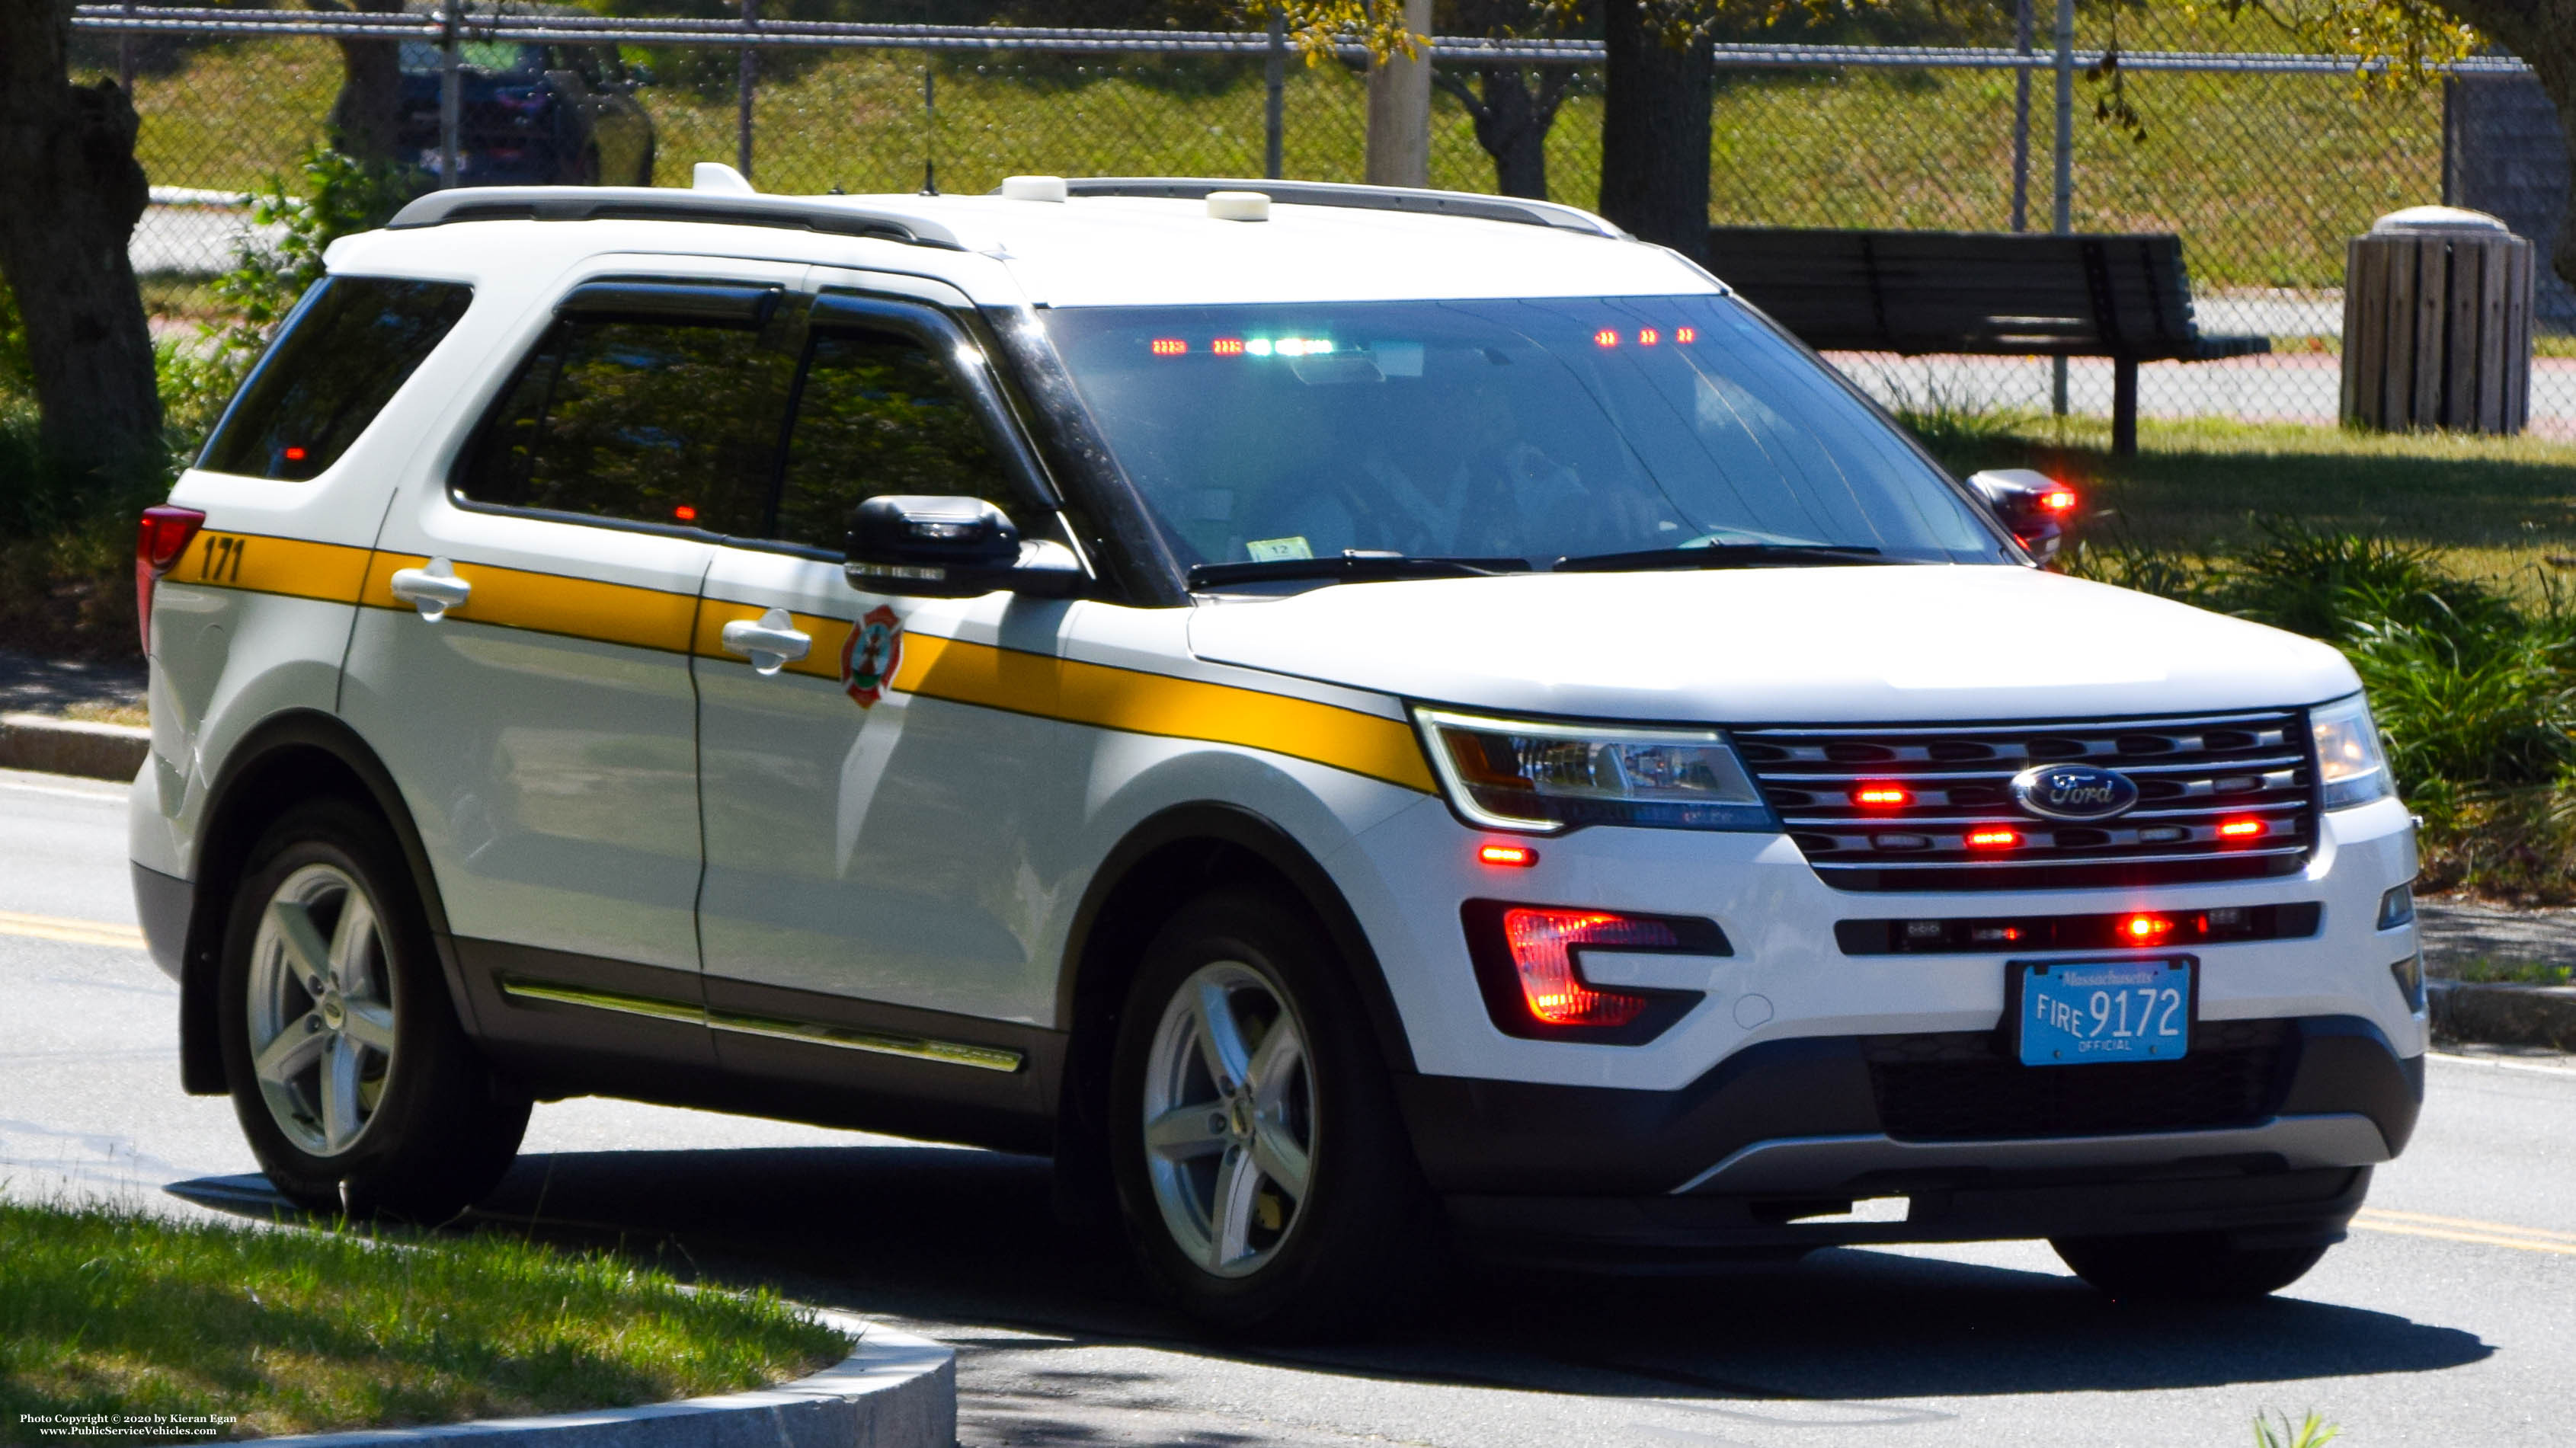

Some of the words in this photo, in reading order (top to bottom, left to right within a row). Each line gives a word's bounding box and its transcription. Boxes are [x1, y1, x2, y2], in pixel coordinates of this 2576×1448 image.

[202, 535, 245, 582] 171
[2050, 773, 2115, 804] Ford
[2062, 970, 2153, 987] Massachusetts
[2037, 993, 2084, 1038] FIRE
[2089, 989, 2181, 1037] 9172
[2078, 1040, 2133, 1053] OFFICIAL
